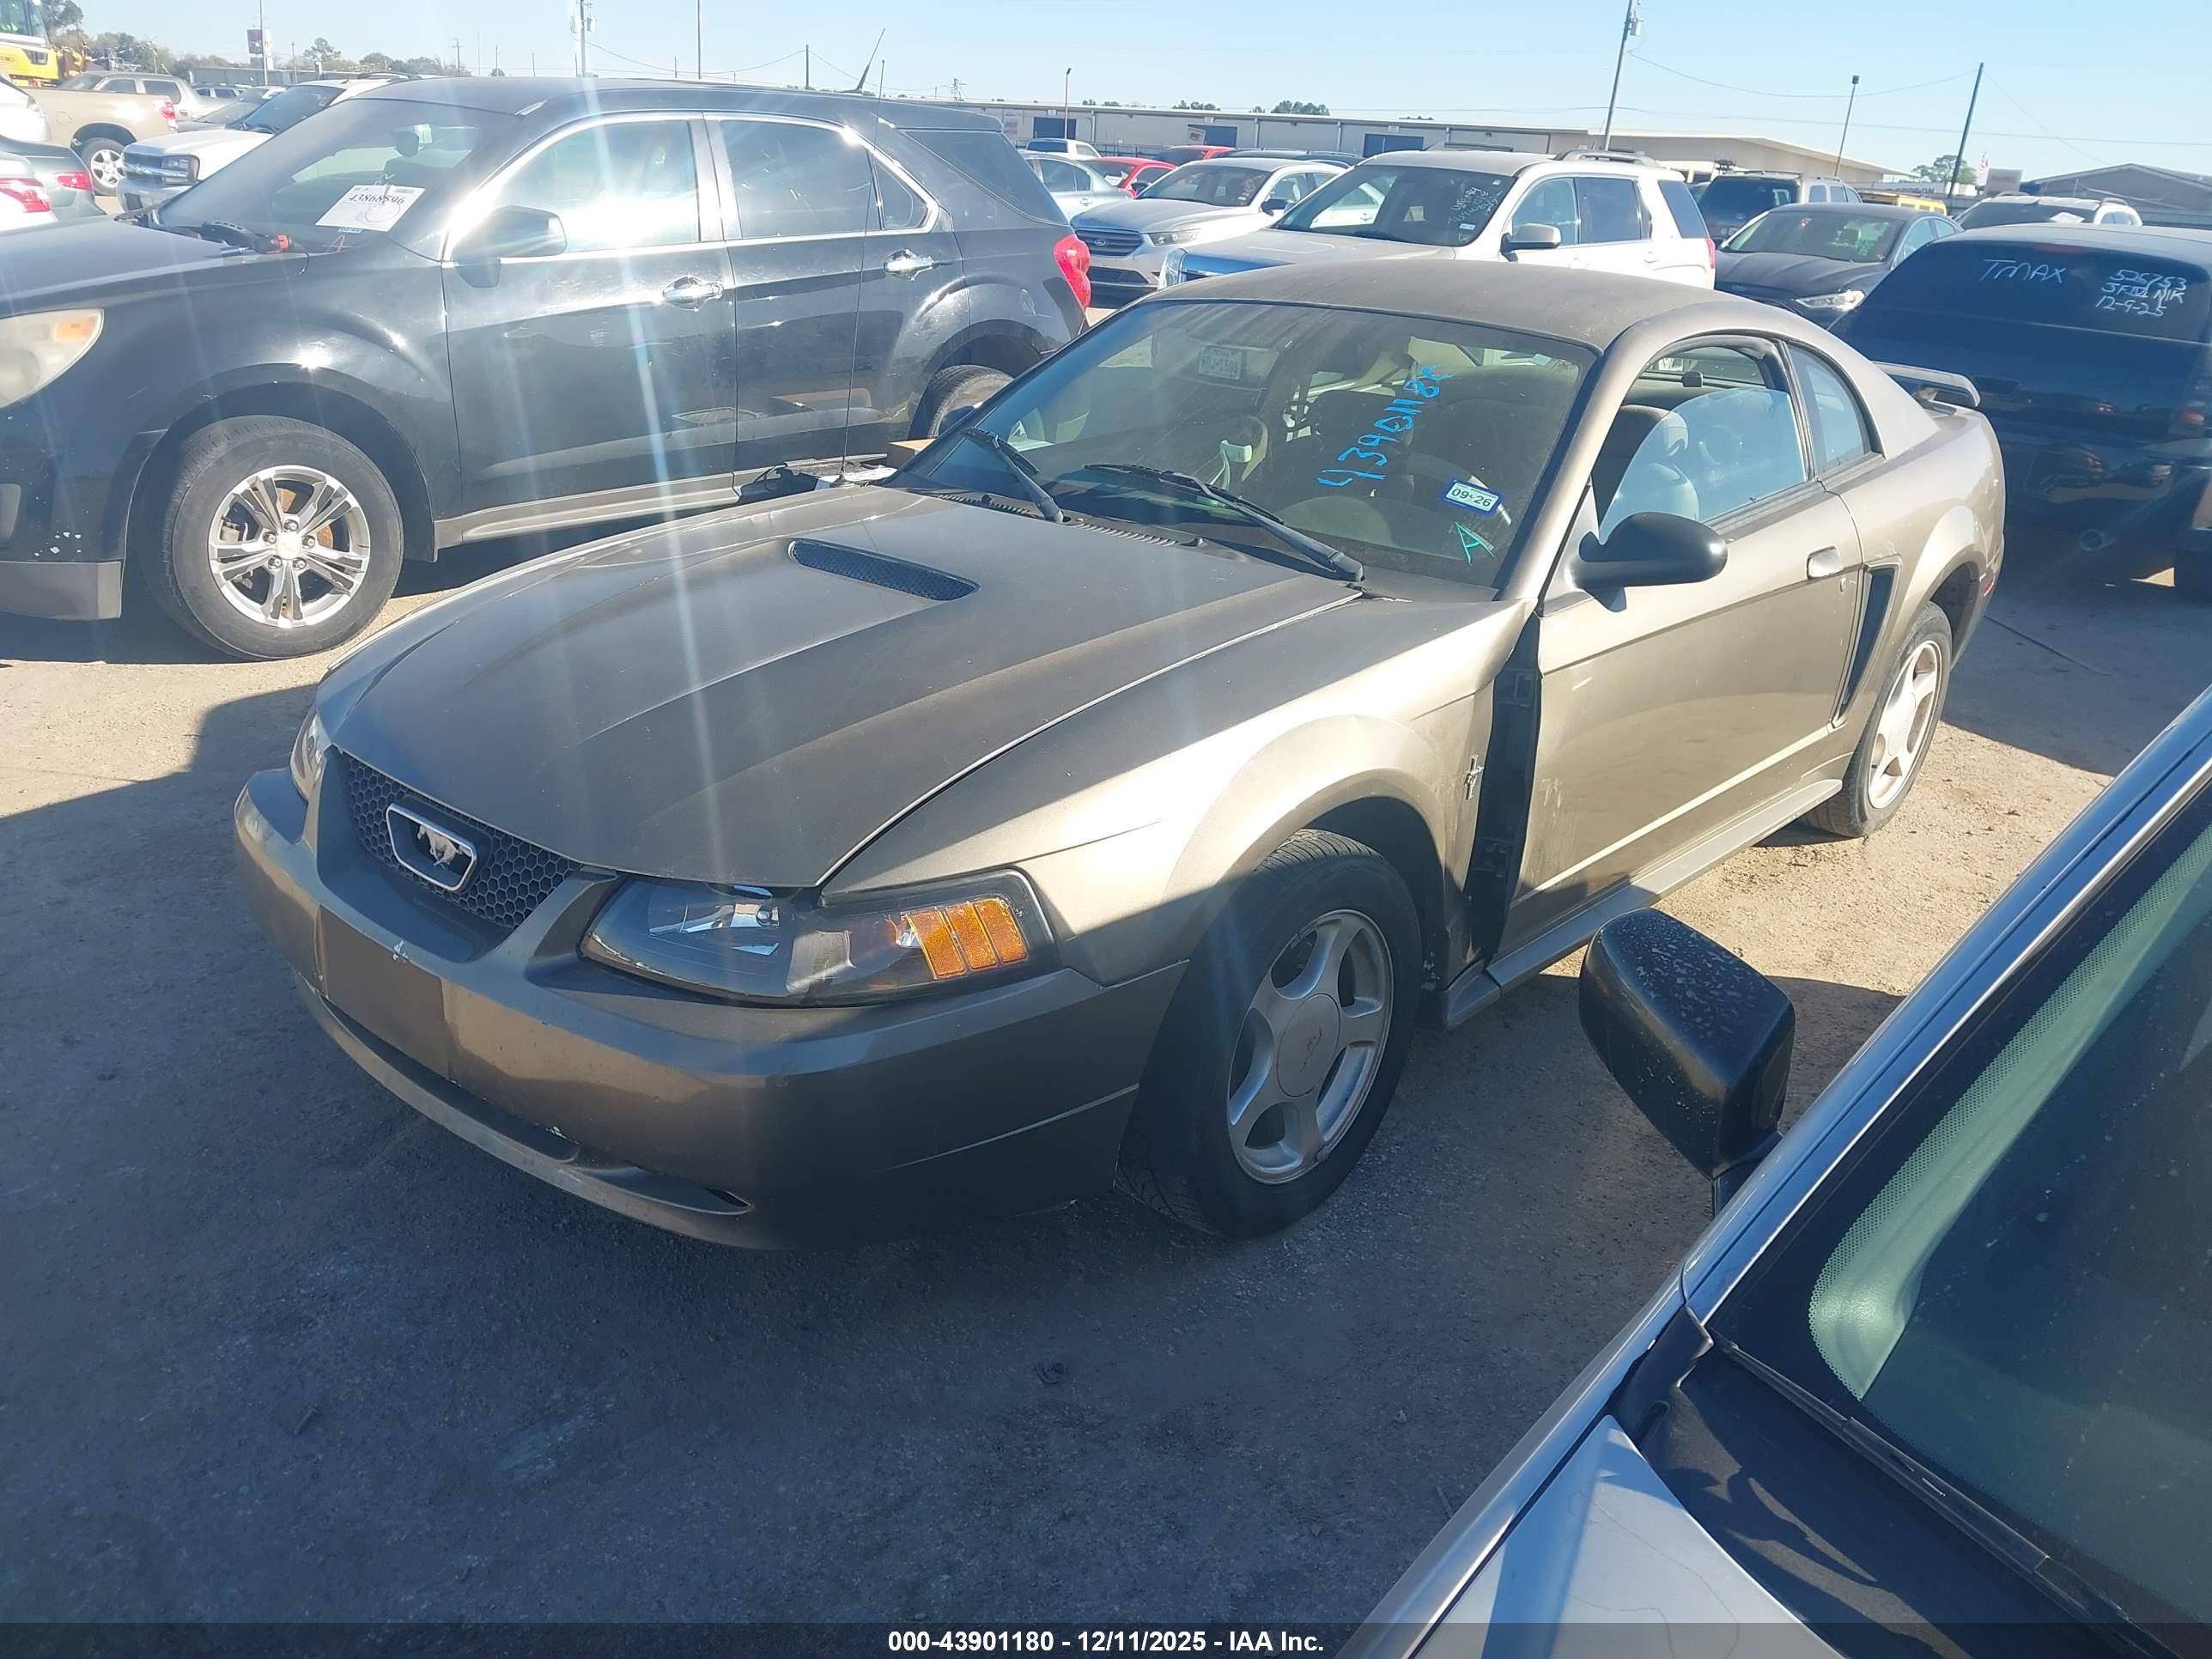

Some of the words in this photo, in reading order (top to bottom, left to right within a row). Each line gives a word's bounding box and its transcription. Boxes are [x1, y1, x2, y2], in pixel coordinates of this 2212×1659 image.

[1979, 258, 2067, 283] TMAX
[2095, 295, 2168, 317] 12-9-25
[1455, 521, 1496, 563] A
